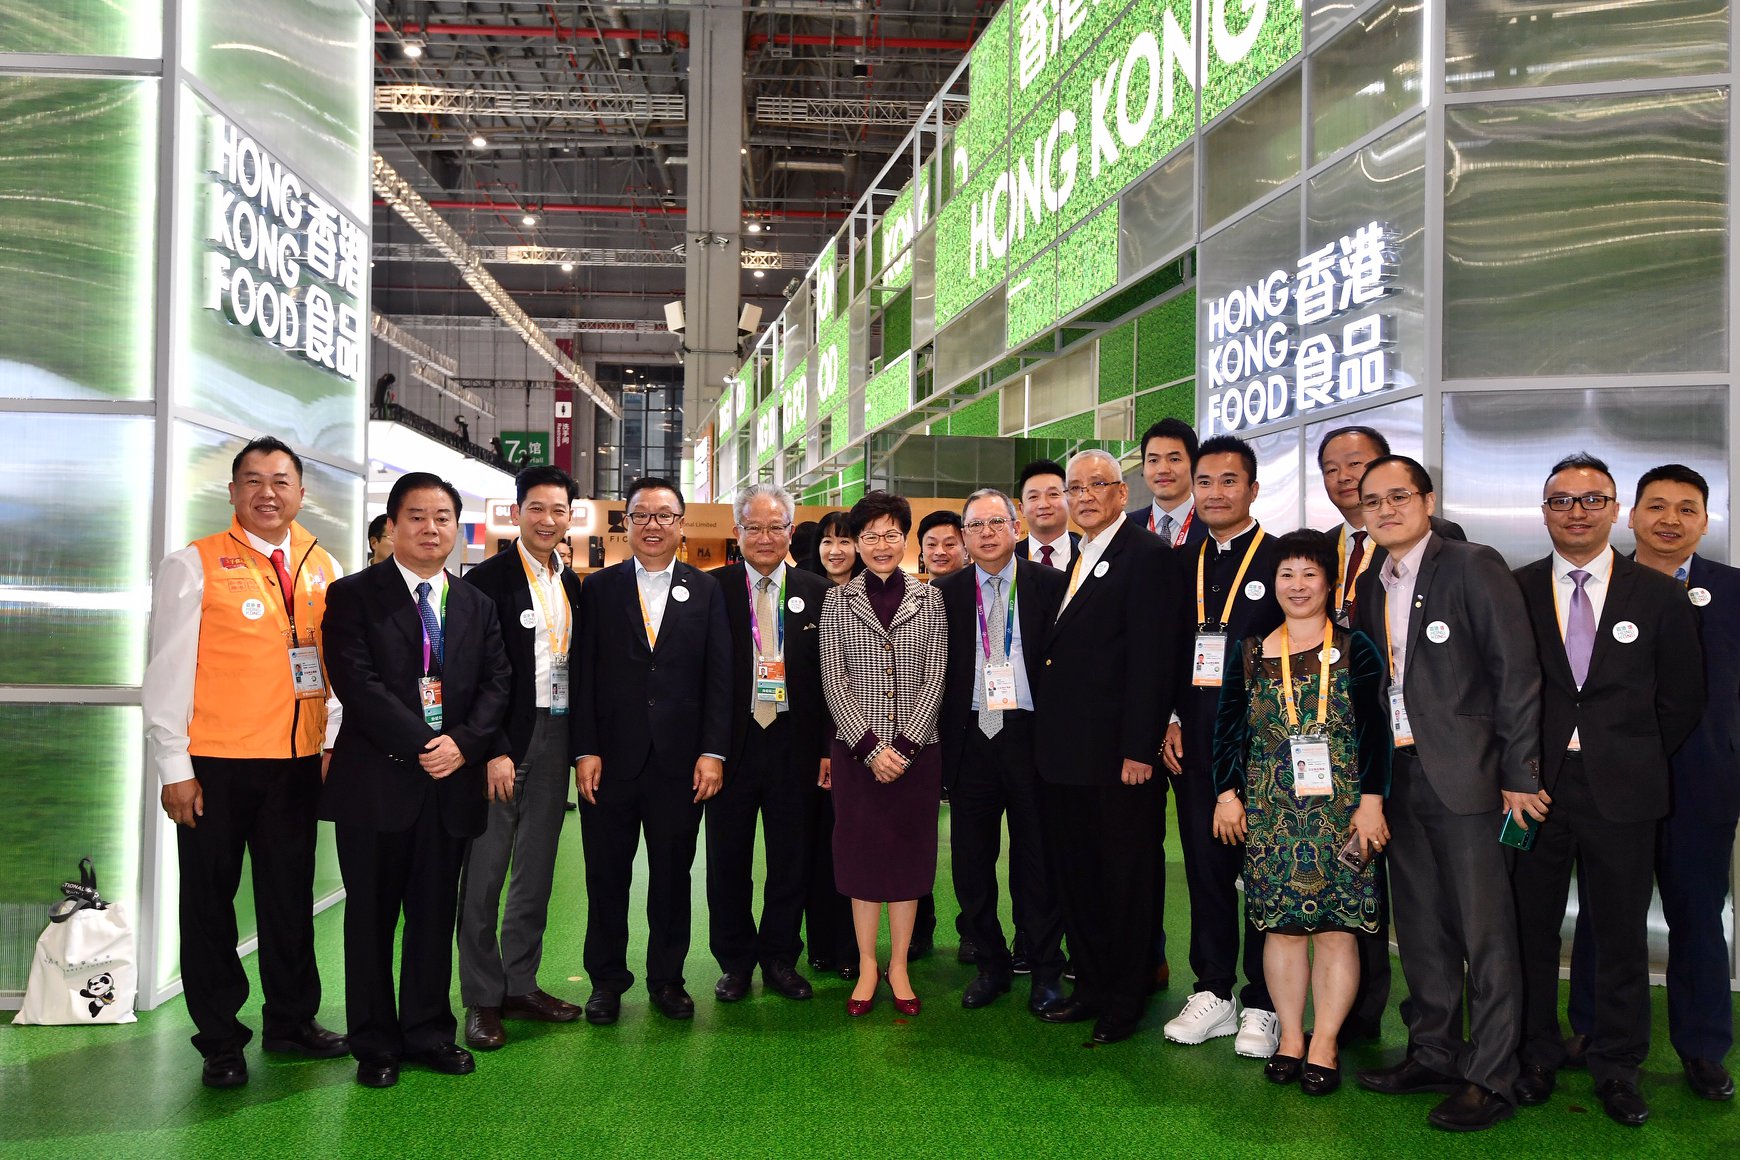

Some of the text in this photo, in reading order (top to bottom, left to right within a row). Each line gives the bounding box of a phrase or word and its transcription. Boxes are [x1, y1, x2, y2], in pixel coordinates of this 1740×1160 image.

[212, 114, 302, 229] HONG
[970, 0, 1269, 278] HONG KONG
[211, 182, 300, 288] KONG
[307, 191, 365, 300] 香港
[1296, 221, 1386, 326] 香港
[208, 252, 299, 347] FOOD
[304, 283, 364, 380] 食品
[1208, 269, 1289, 342] HONG
[1208, 321, 1289, 389] KONG
[1294, 313, 1385, 410] 食品
[529, 442, 541, 454] 馆
[1208, 374, 1288, 436] FOOD
